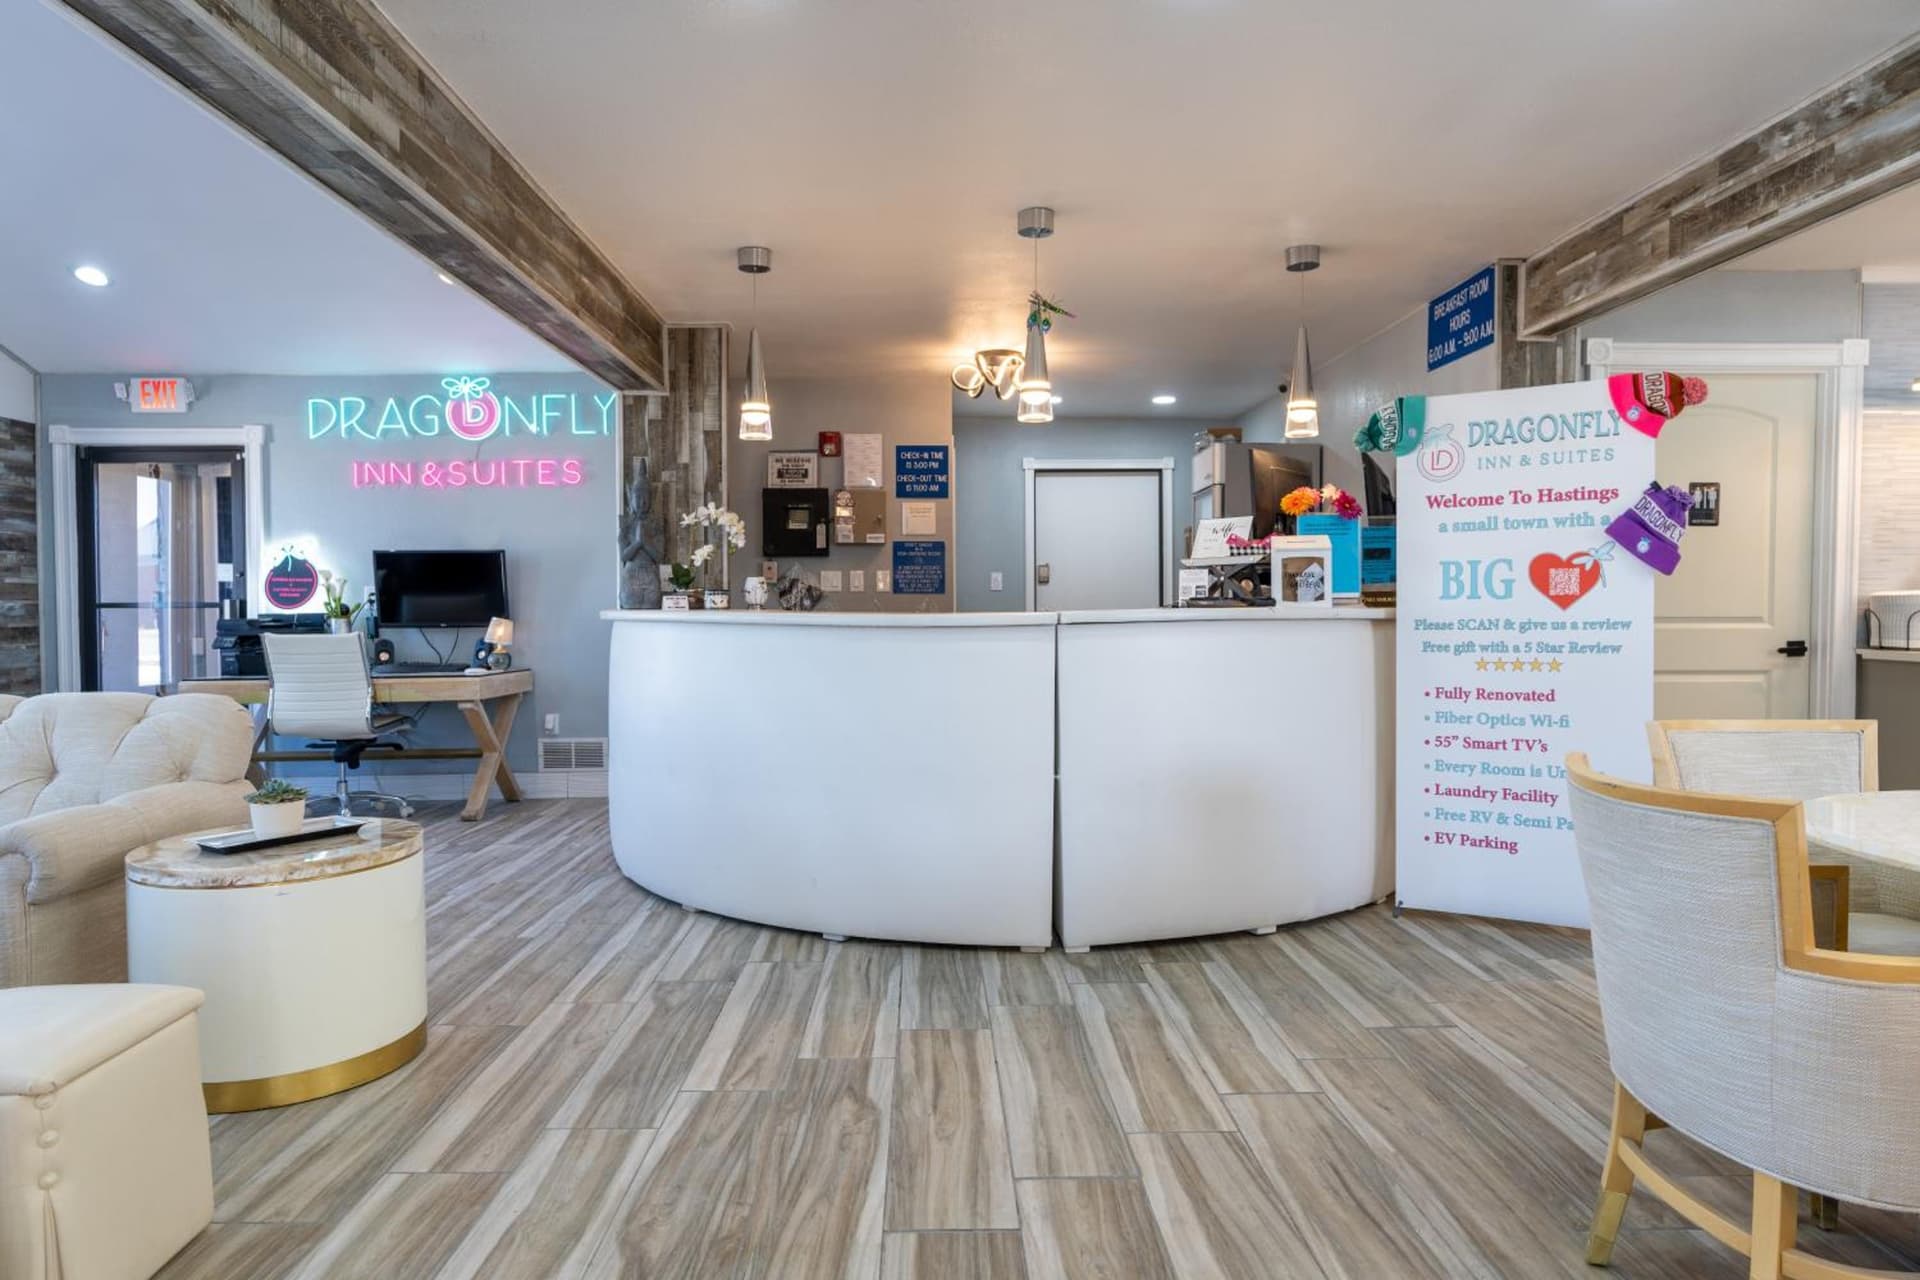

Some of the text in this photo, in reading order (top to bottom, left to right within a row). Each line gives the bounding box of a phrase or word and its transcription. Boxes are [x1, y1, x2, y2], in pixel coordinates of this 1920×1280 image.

[1434, 276, 1489, 321] BREAKFAST ROOM
[1449, 308, 1471, 333] HOURS
[1463, 326, 1479, 347] 9:00
[140, 380, 177, 408] EXIT
[308, 390, 616, 440] DRAGONFLY
[1468, 409, 1621, 447] DRAGONFLY
[900, 451, 944, 459] CHECK-IN TIME
[929, 461, 940, 469] PM
[1477, 448, 1615, 470] INN & SUITES
[353, 459, 584, 487] INN & SUITES
[897, 474, 948, 482] CHECK-OUT TIME
[929, 484, 939, 492] AM
[1426, 487, 1619, 509] Welcome To Hastings
[1439, 512, 1611, 533] a small town with a
[1634, 496, 1683, 542] DRAGONFLY
[1439, 558, 1516, 600] BIG
[1414, 619, 1632, 634] Please SCAN & give us a review
[1422, 641, 1623, 656] Free gift with a 5 Star Review
[1435, 687, 1556, 703] Fully Renovated
[1435, 711, 1571, 729] Fiber Optics Wi-fi
[1463, 736, 1507, 750] Smart
[1435, 759, 1476, 776] Every
[1481, 762, 1525, 776] Room
[1530, 763, 1543, 777] is
[1435, 783, 1559, 807] Laundry Facility
[1435, 807, 1466, 821] Free
[1470, 810, 1493, 823] RV
[1496, 812, 1510, 825] &
[1513, 813, 1552, 829] Semi
[1434, 832, 1519, 855] EV Parking
